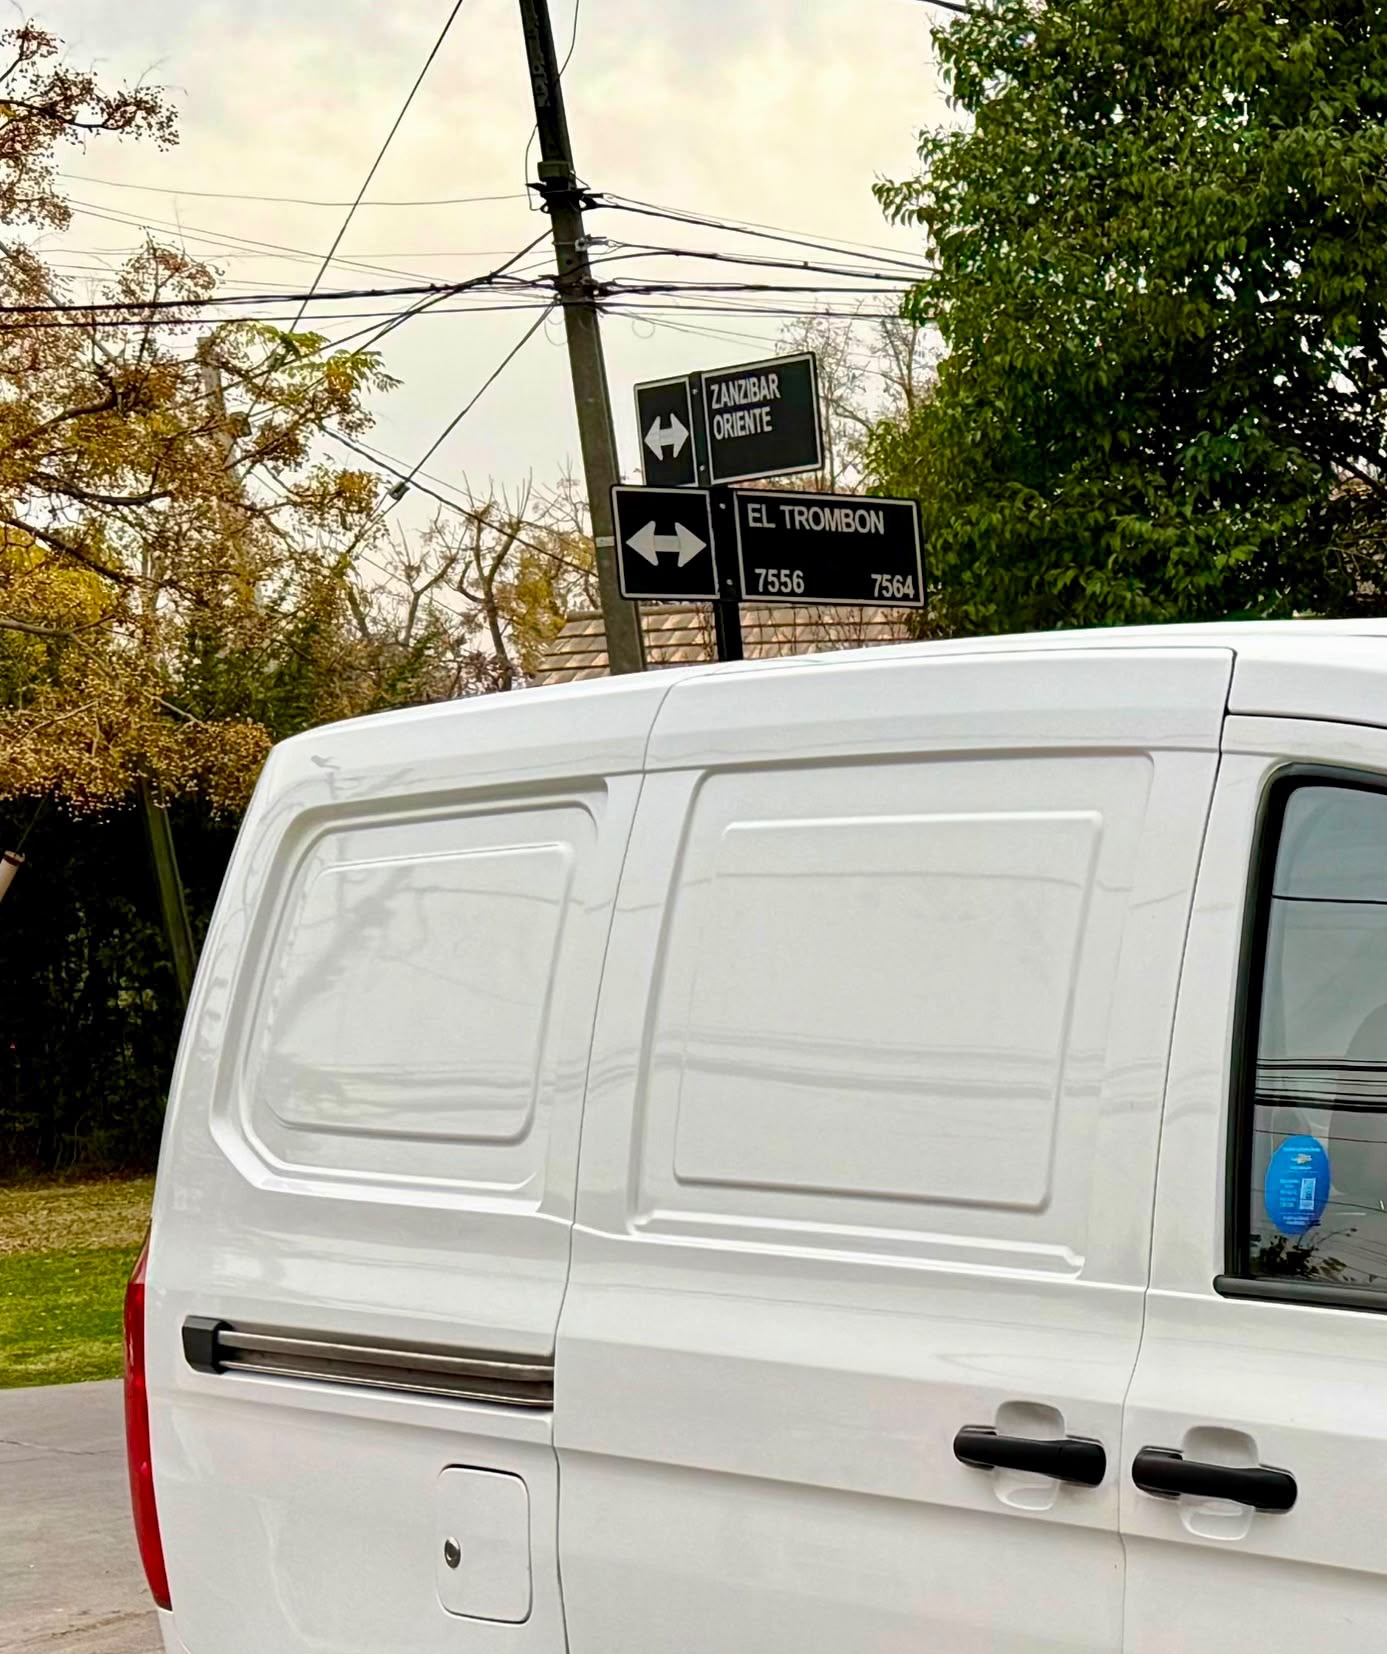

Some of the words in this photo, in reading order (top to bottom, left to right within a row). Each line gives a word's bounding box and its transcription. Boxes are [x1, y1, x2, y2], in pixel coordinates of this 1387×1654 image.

[710, 373, 781, 410] ZANZIBAR
[713, 406, 773, 441] ORIENTE
[747, 503, 776, 529] EL
[780, 504, 885, 535] TROMBON
[755, 568, 805, 594] 7556
[871, 573, 915, 599] 7564
